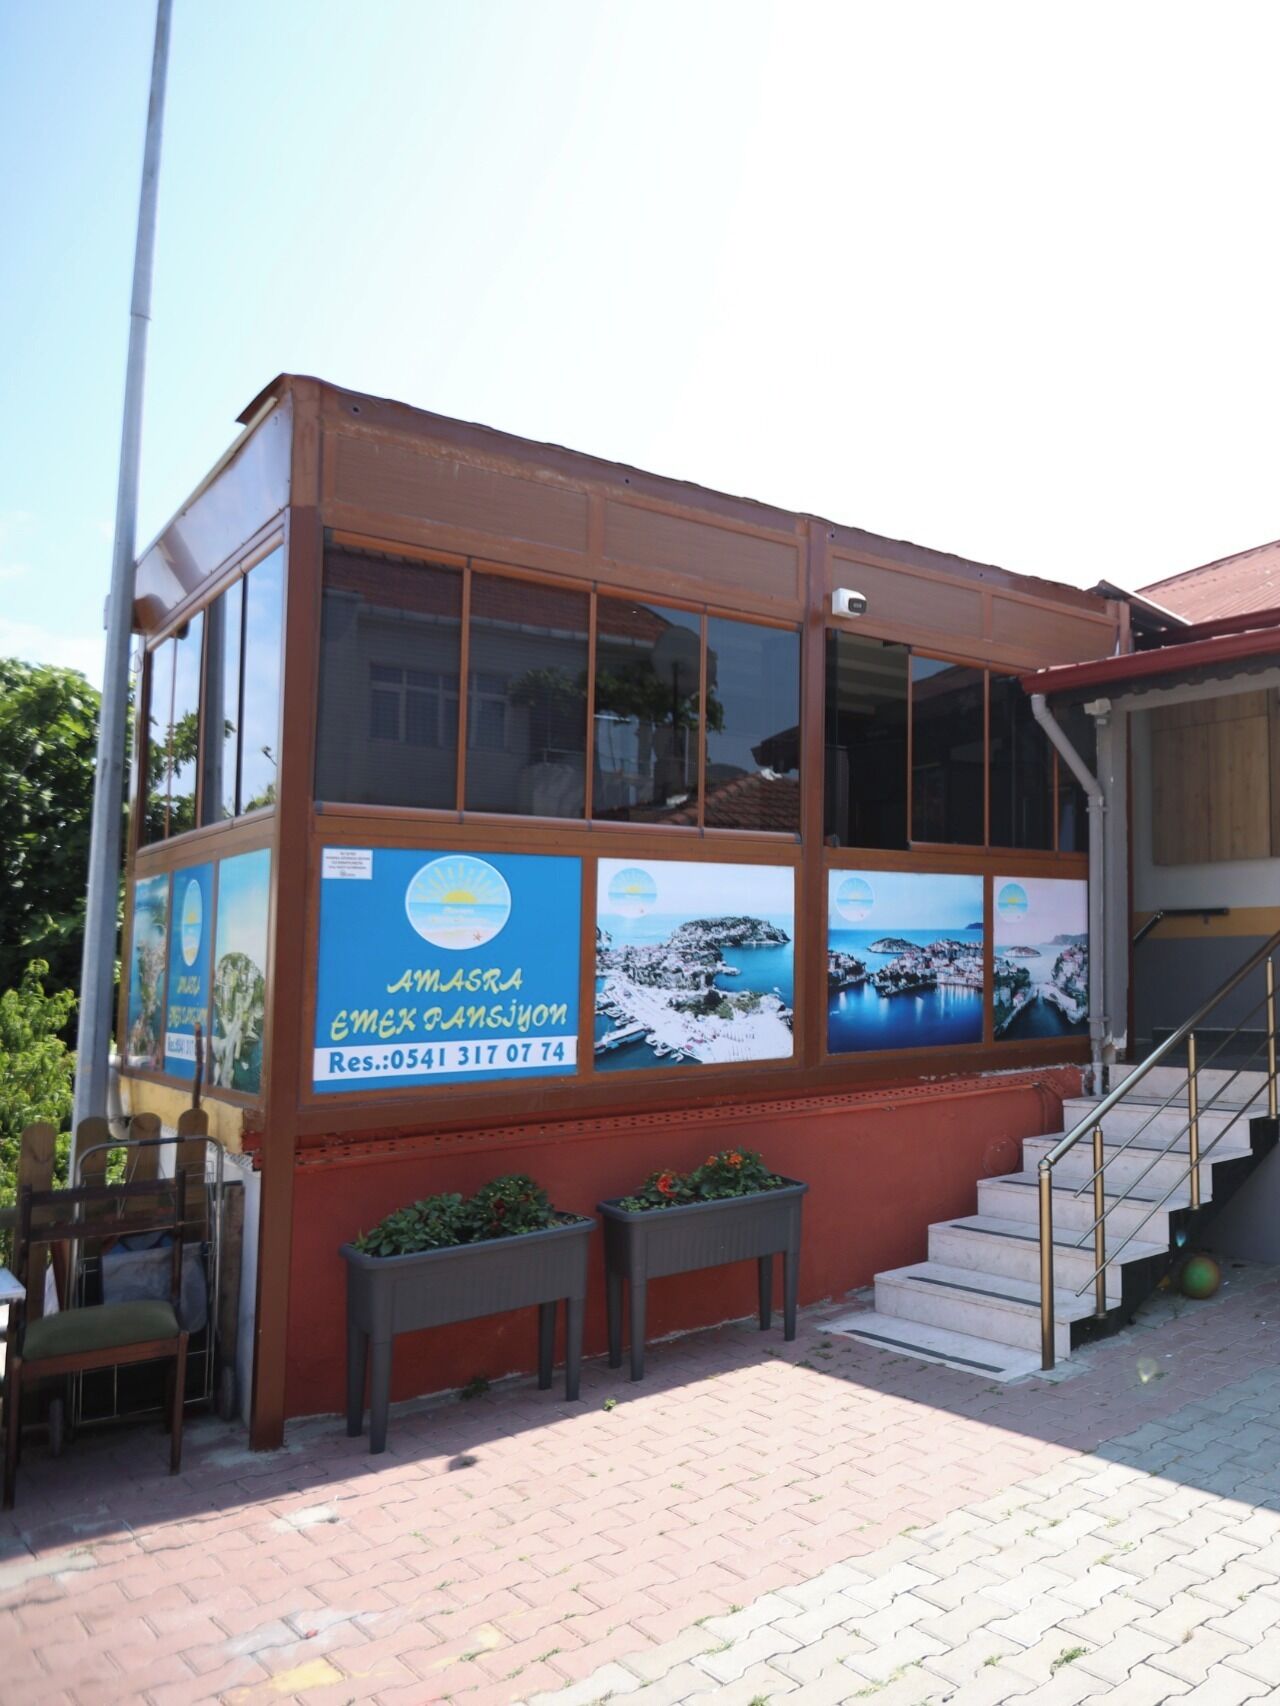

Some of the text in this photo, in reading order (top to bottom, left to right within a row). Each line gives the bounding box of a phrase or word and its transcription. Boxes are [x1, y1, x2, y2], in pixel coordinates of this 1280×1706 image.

[387, 967, 523, 994] AMASRA
[330, 1007, 417, 1041] EMEK
[329, 1041, 565, 1074] Res.:0541 317 07 74
